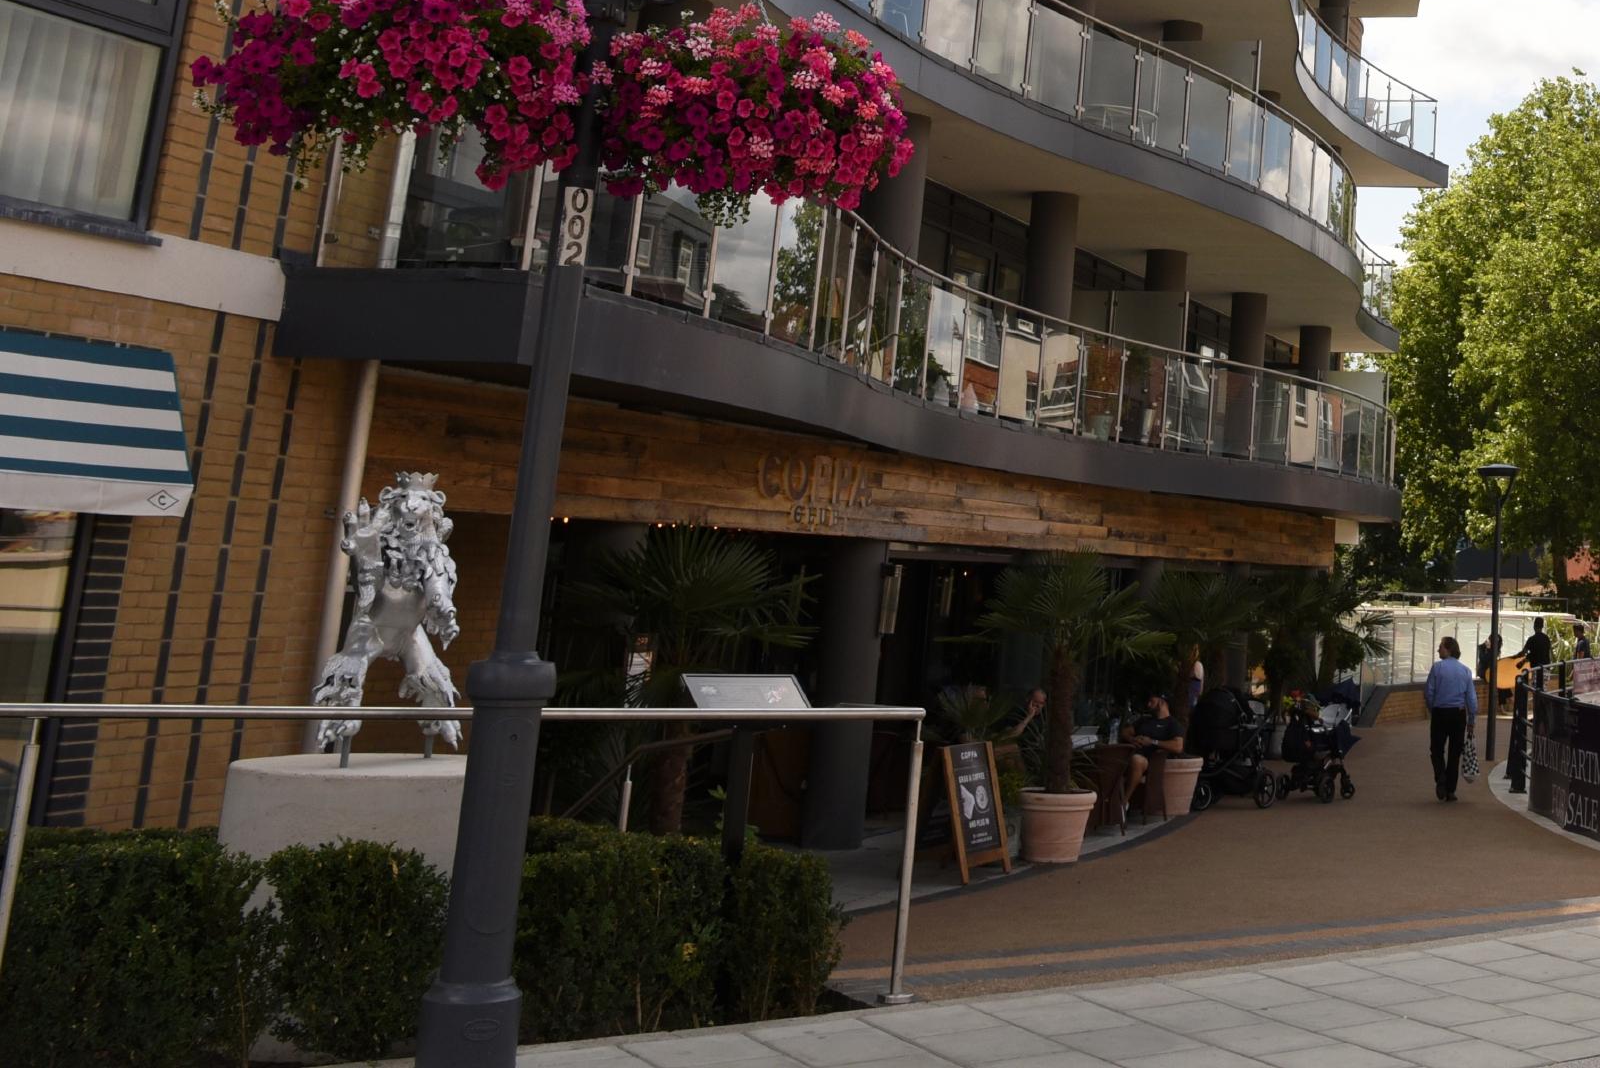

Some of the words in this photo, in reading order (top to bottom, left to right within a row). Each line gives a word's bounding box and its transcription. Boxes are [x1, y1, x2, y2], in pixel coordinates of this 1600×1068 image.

[564, 188, 589, 266] 002
[759, 452, 872, 507] COPPA
[158, 495, 167, 506] C
[793, 504, 843, 529] CLUB
[1533, 735, 1561, 772] UXURY
[1566, 792, 1599, 833] SALE
